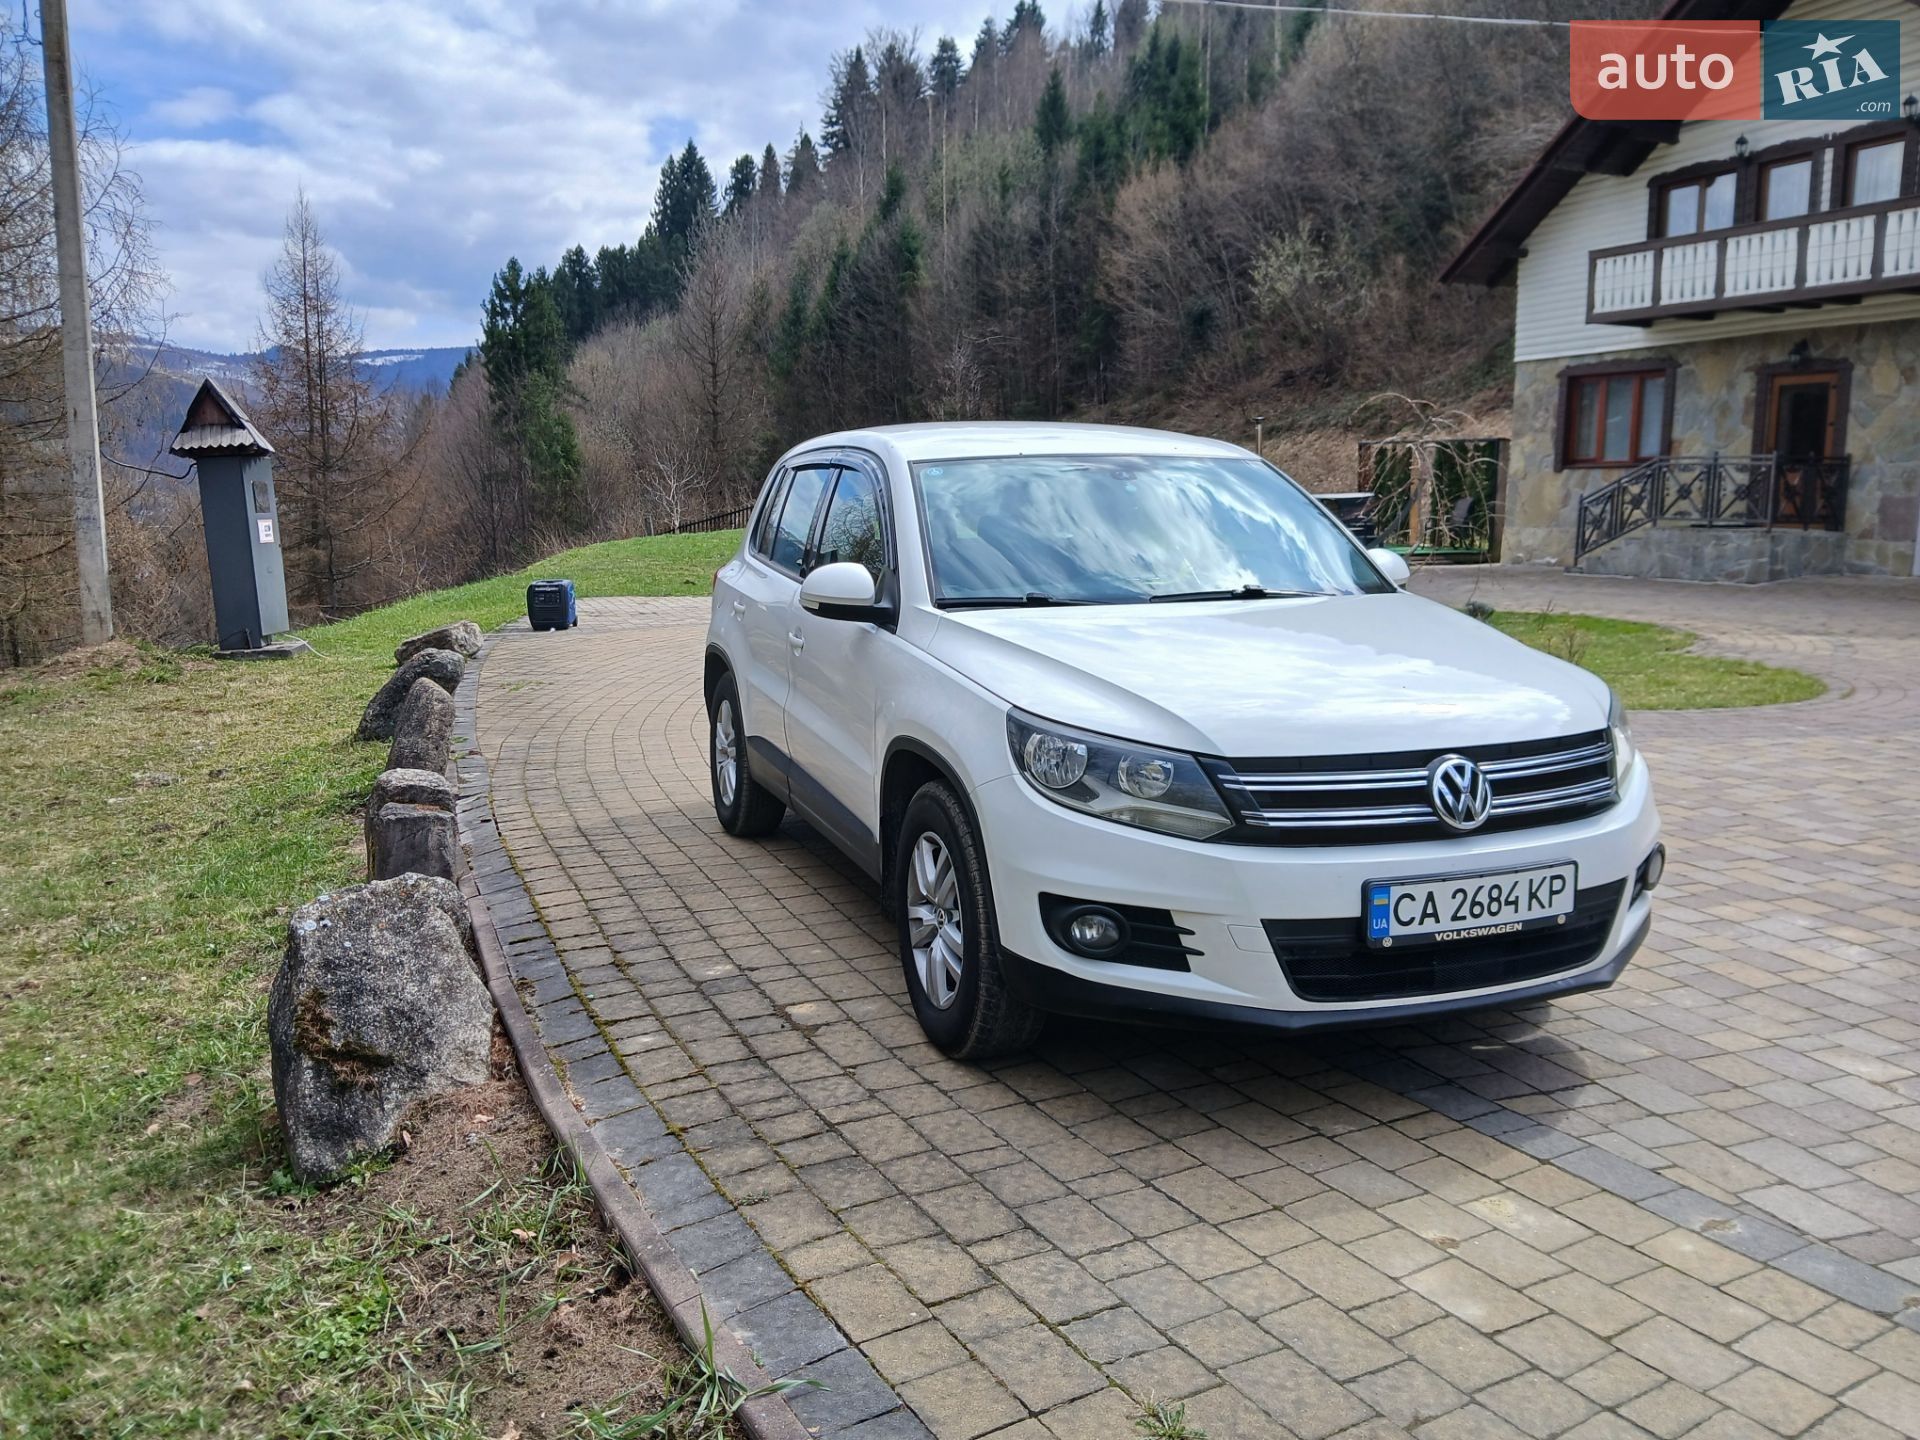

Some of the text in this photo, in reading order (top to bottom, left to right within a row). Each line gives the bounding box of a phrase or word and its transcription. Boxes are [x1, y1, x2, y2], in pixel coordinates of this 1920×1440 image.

[1393, 874, 1567, 927] CA 2684 KP
[1373, 918, 1388, 929] UA
[1435, 922, 1523, 942] VOLKSWAGEN
